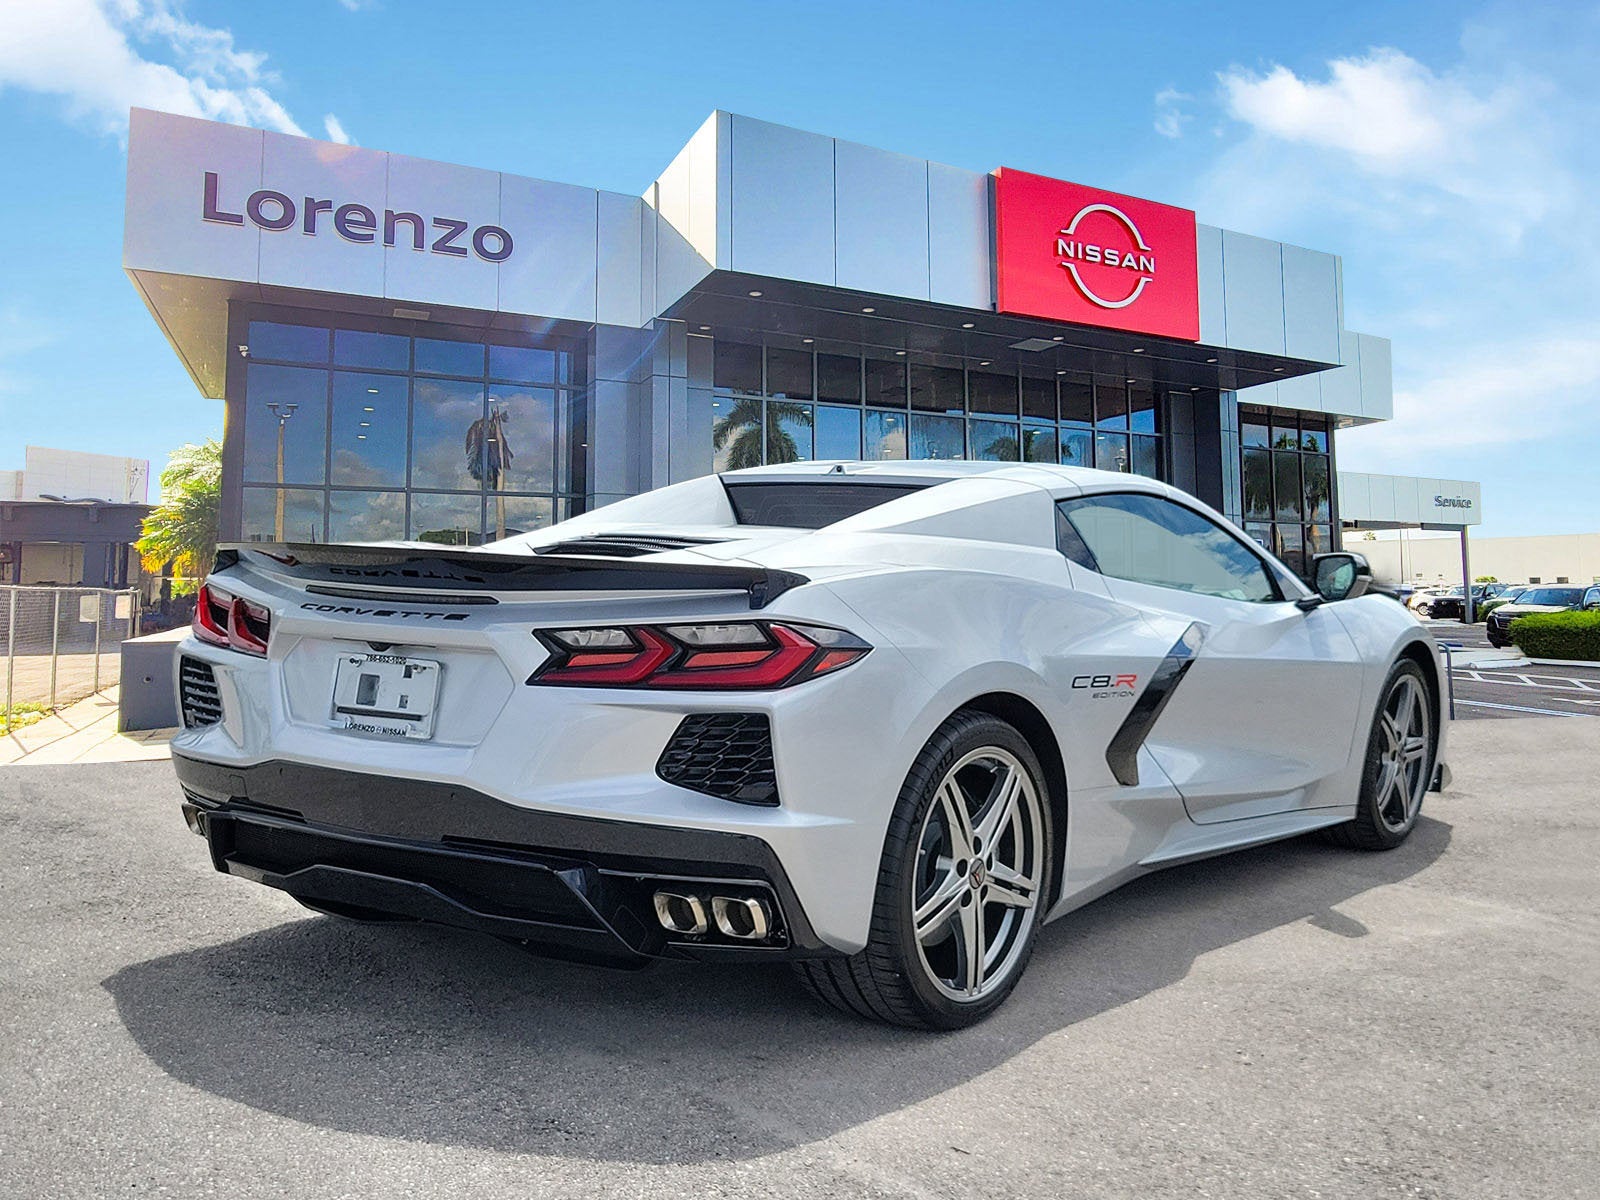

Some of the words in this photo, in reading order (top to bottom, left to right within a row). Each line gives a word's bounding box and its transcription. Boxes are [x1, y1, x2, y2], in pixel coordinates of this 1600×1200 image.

[202, 171, 514, 263] Lorenzo
[1058, 238, 1155, 273] NISSAN
[1434, 495, 1472, 508] Service
[300, 602, 471, 621] CORVETTE
[1071, 674, 1137, 689] C8.R
[1092, 690, 1135, 699] EDITION
[344, 722, 375, 733] LORENZO
[382, 727, 407, 736] NISSAN
